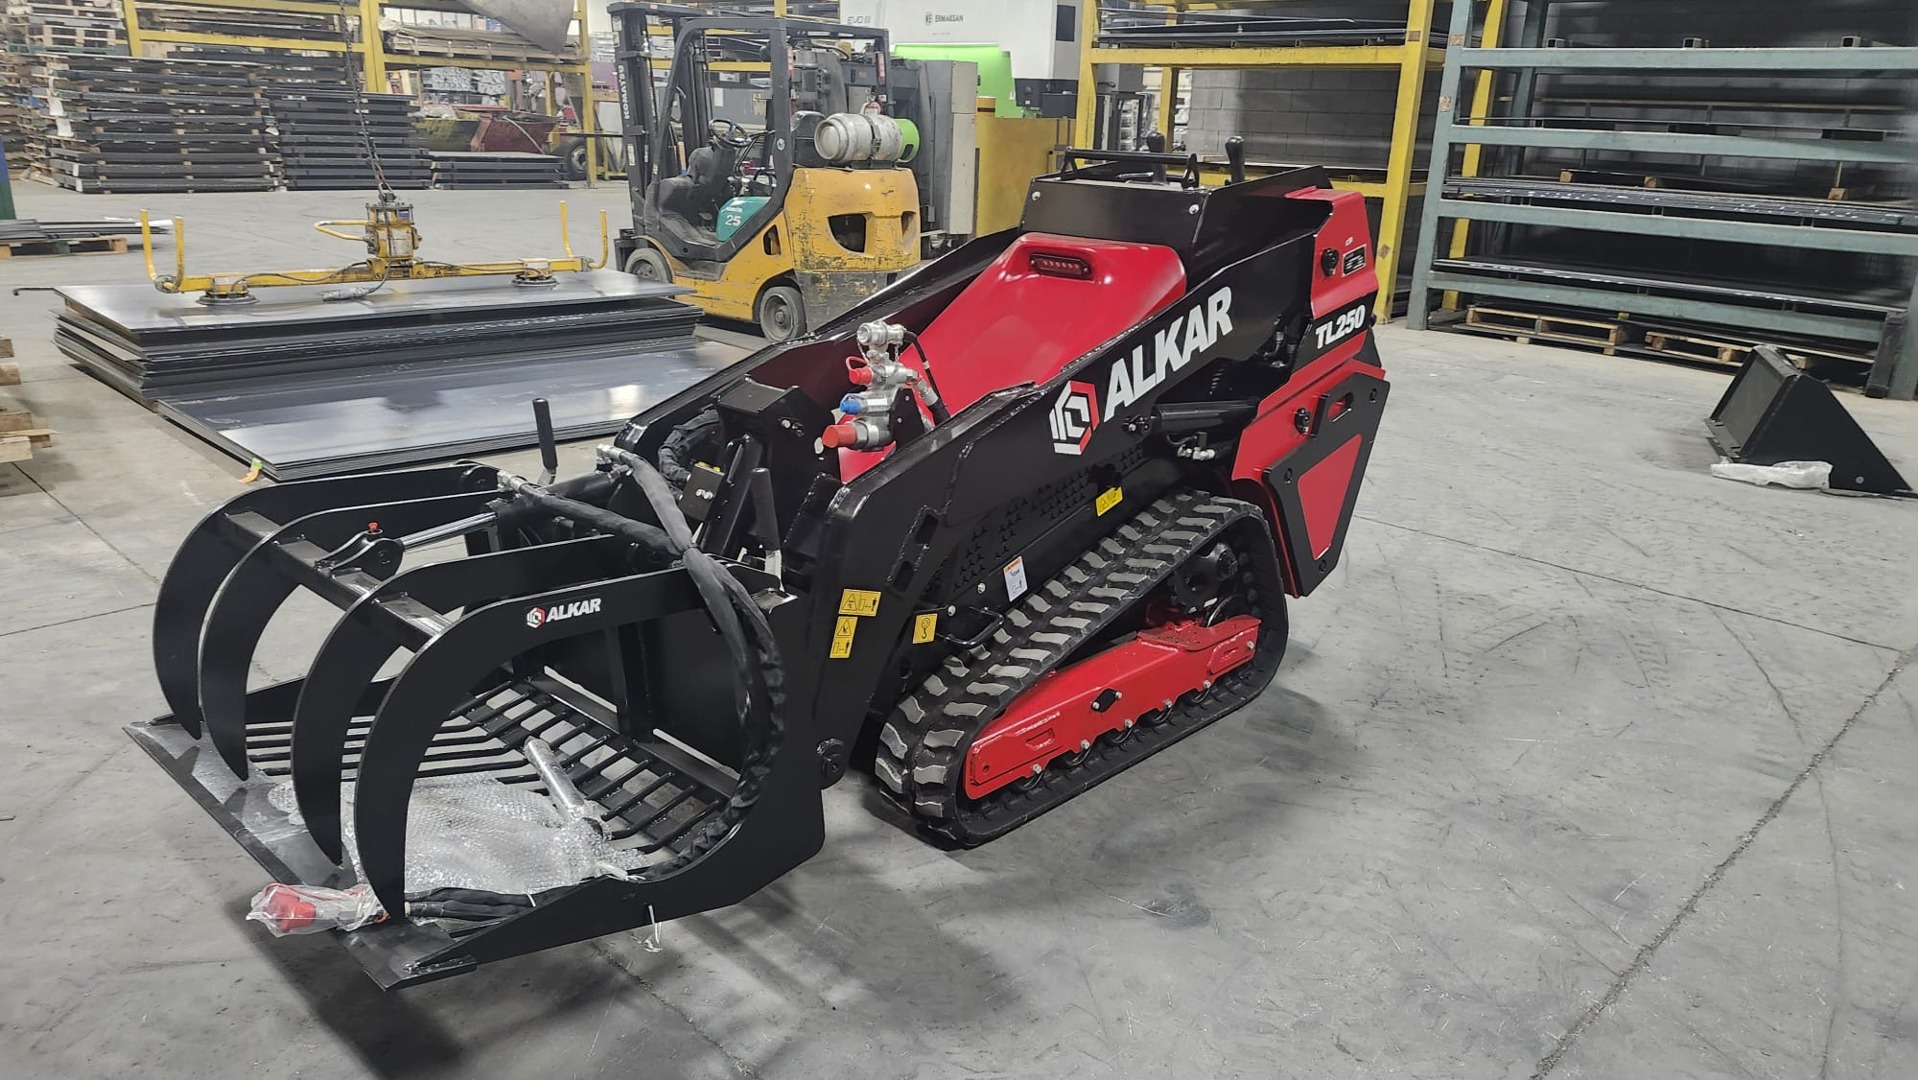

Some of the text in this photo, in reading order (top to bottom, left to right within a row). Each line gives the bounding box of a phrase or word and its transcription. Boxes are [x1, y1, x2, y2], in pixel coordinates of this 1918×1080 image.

[618, 64, 630, 120] KOMATSU
[725, 214, 742, 227] 25
[1315, 304, 1366, 350] TL250
[1103, 286, 1233, 423] ALKAR
[545, 598, 602, 623] ALKAR
